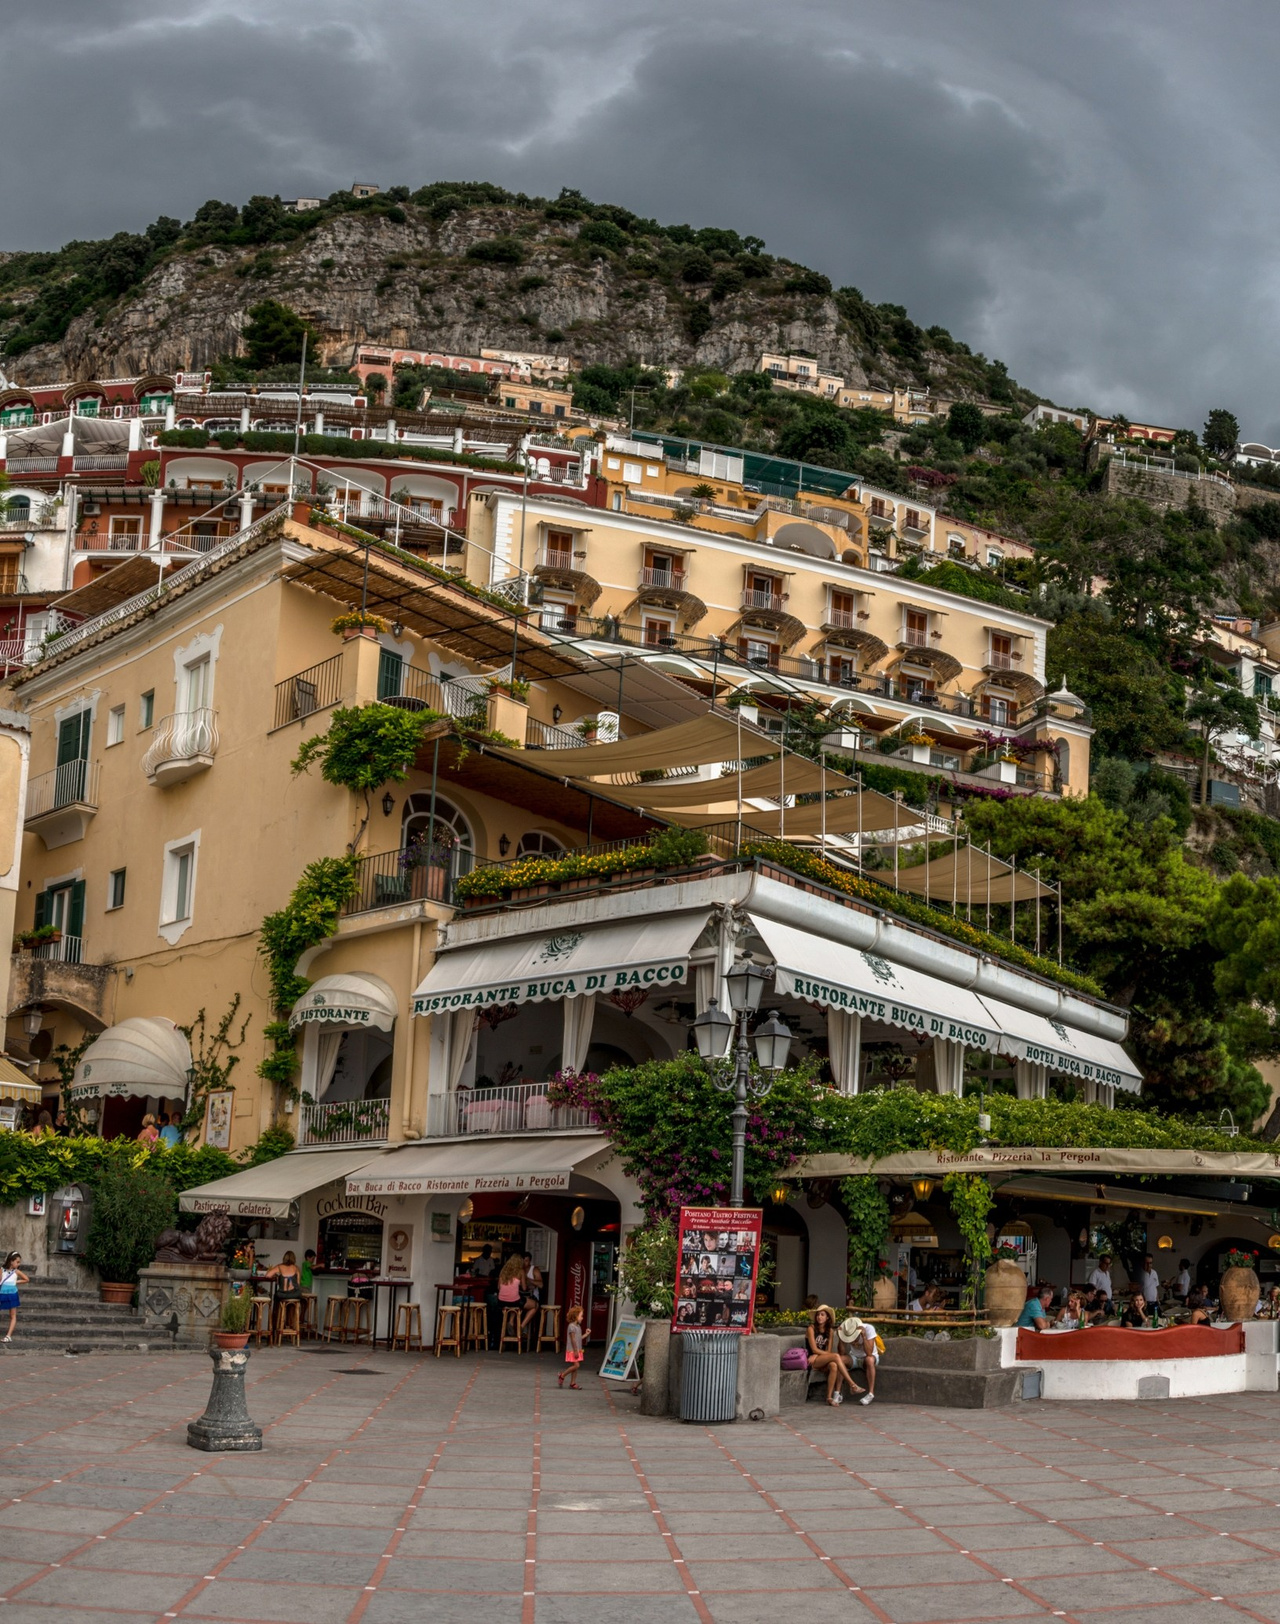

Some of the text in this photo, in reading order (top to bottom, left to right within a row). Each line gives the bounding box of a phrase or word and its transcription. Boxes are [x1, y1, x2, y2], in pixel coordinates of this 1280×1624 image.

[414, 965, 685, 1013] RISTORANTE BUCA DI BACCO
[300, 1008, 370, 1022] RISTORANTE
[794, 978, 987, 1046] RISTORANTE BUCA DI BACCO
[1026, 1046, 1121, 1086] HOTEL BUCA DI BACCO
[936, 1151, 1100, 1164] Ristorante Pizzeria la Pergola
[348, 1175, 565, 1192] Bar Buca di Bacco Ristorante Pizzeria la Pergola
[193, 1200, 272, 1215] Pasticceria Gelateria
[316, 1193, 389, 1216] Cocktail Bar
[684, 1210, 711, 1218] POSITANO
[388, 1265, 407, 1273] pizzeria
